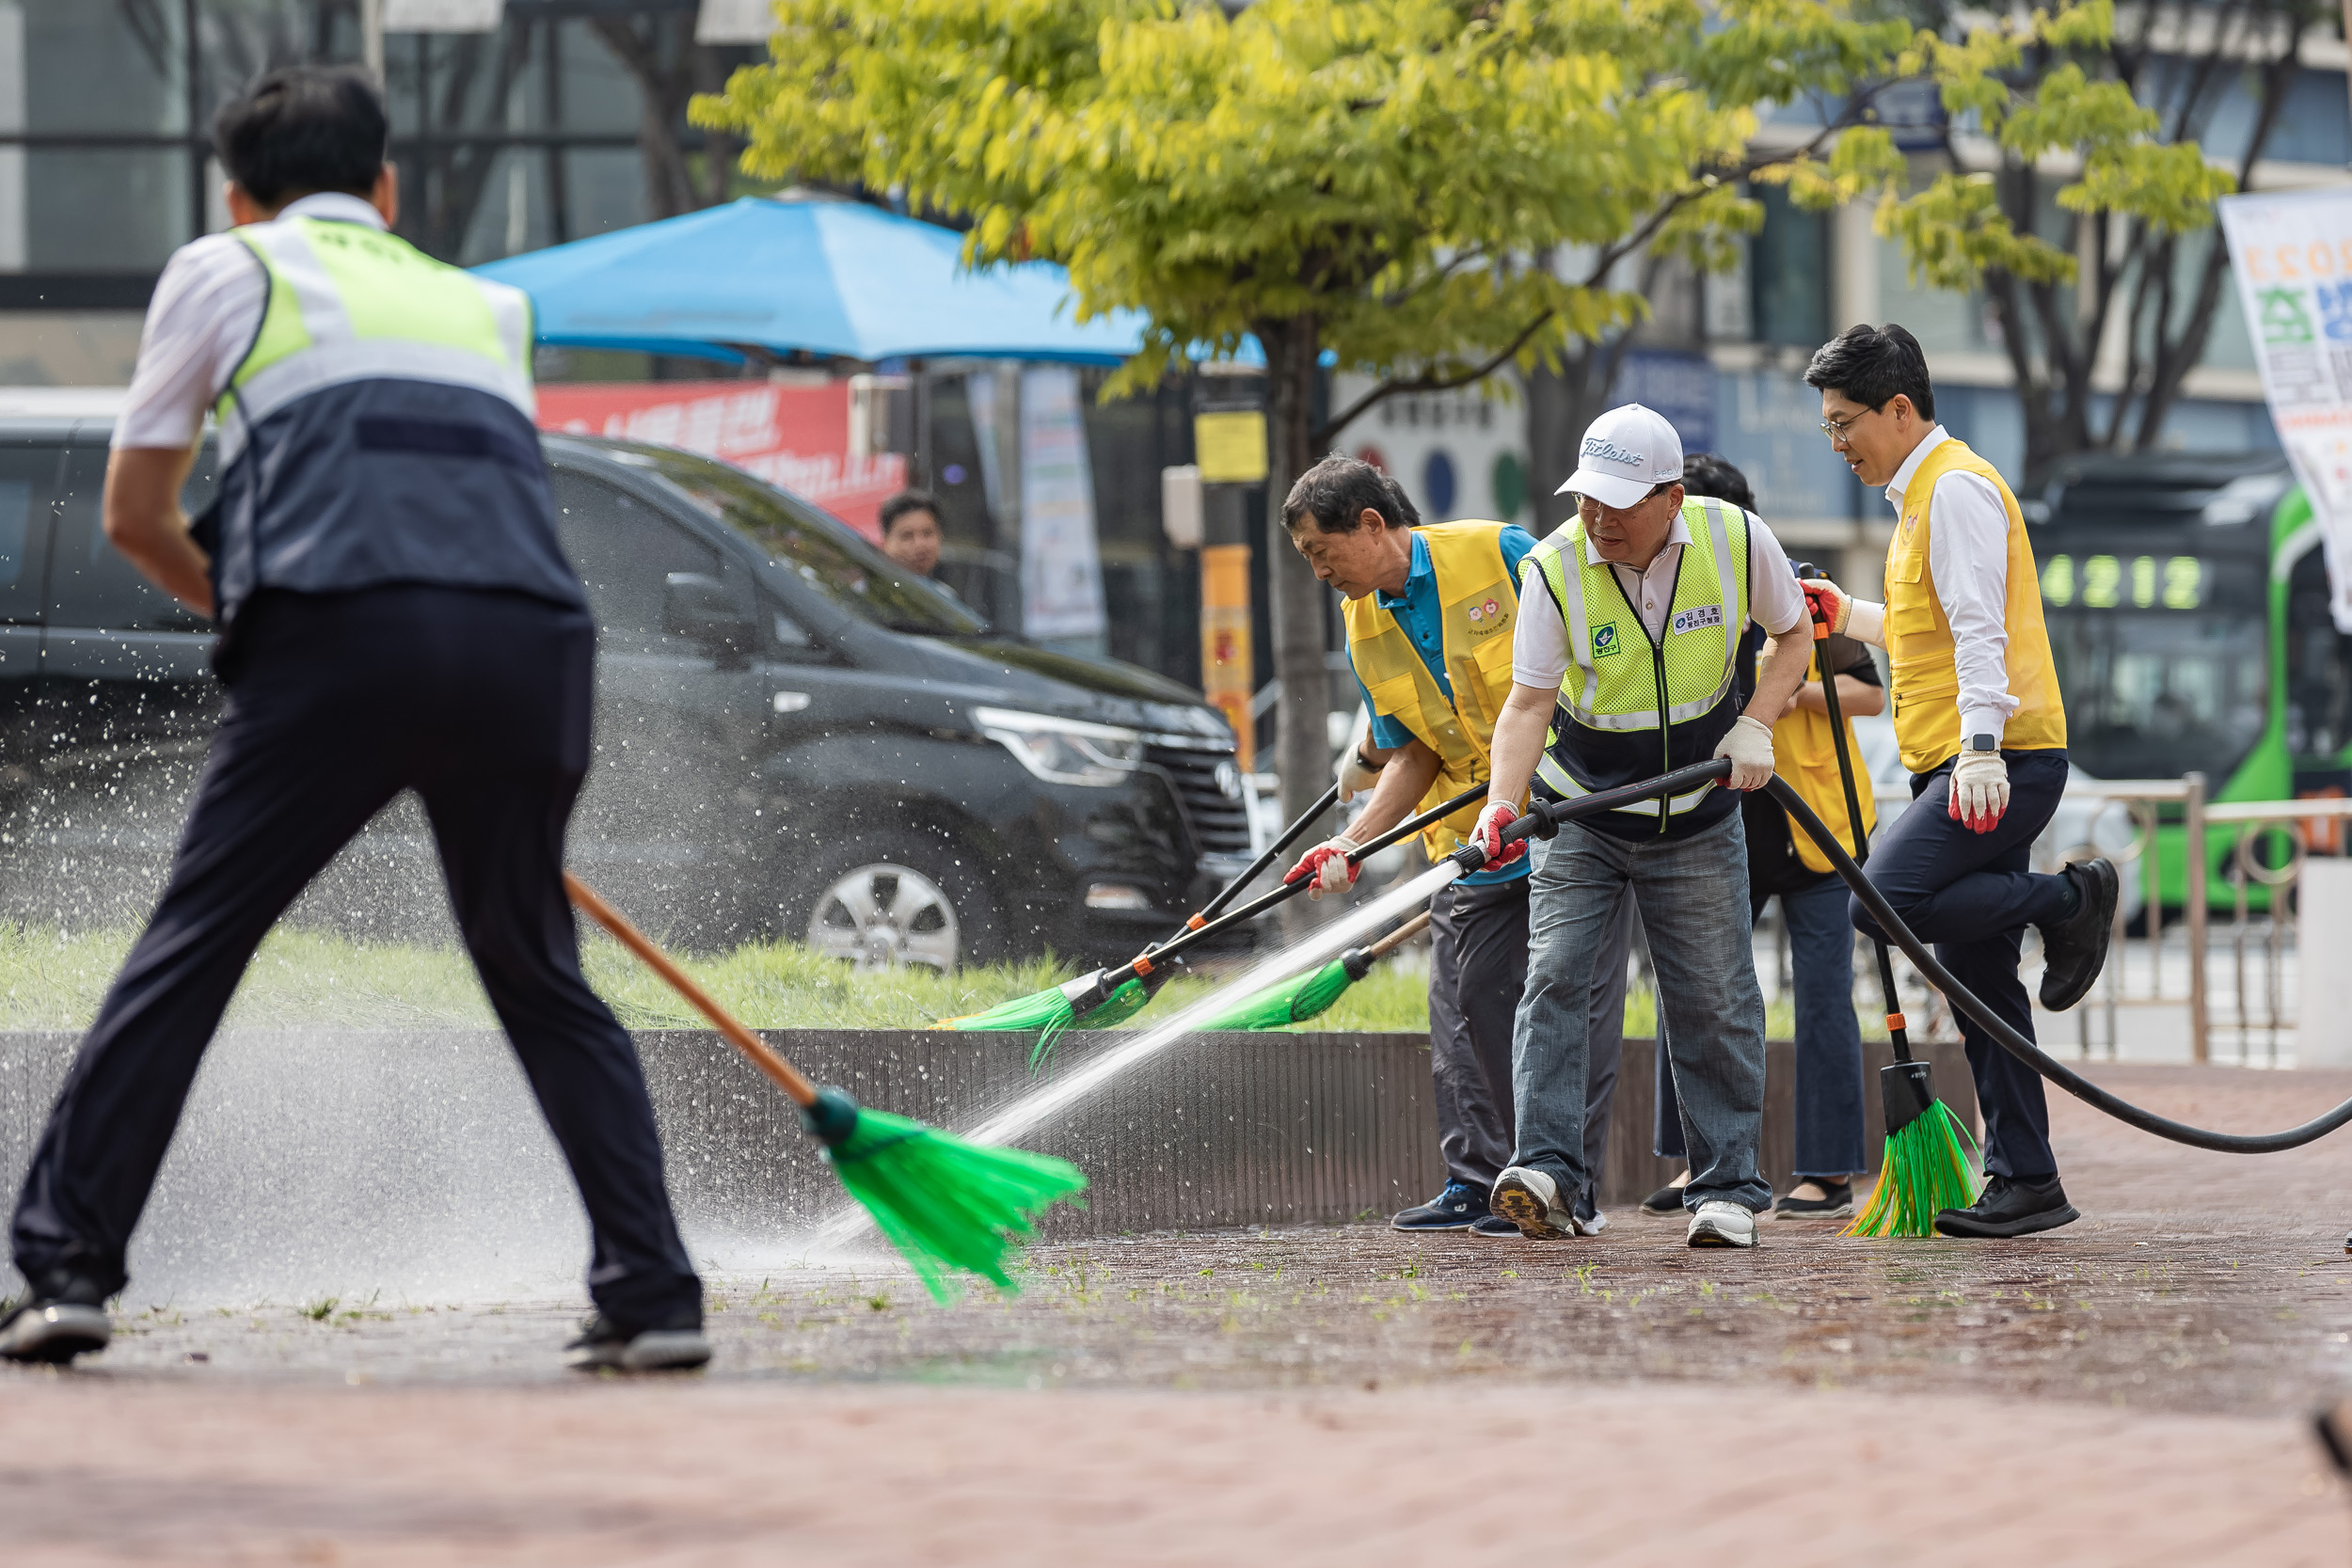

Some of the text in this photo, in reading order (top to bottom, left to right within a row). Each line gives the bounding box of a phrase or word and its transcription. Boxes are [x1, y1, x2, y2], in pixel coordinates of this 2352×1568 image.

[1581, 437, 1645, 467] Titleist
[2040, 554, 2201, 610] 4212
[1687, 616, 1721, 628] 광진구청장
[1596, 644, 1616, 655] 광진구
